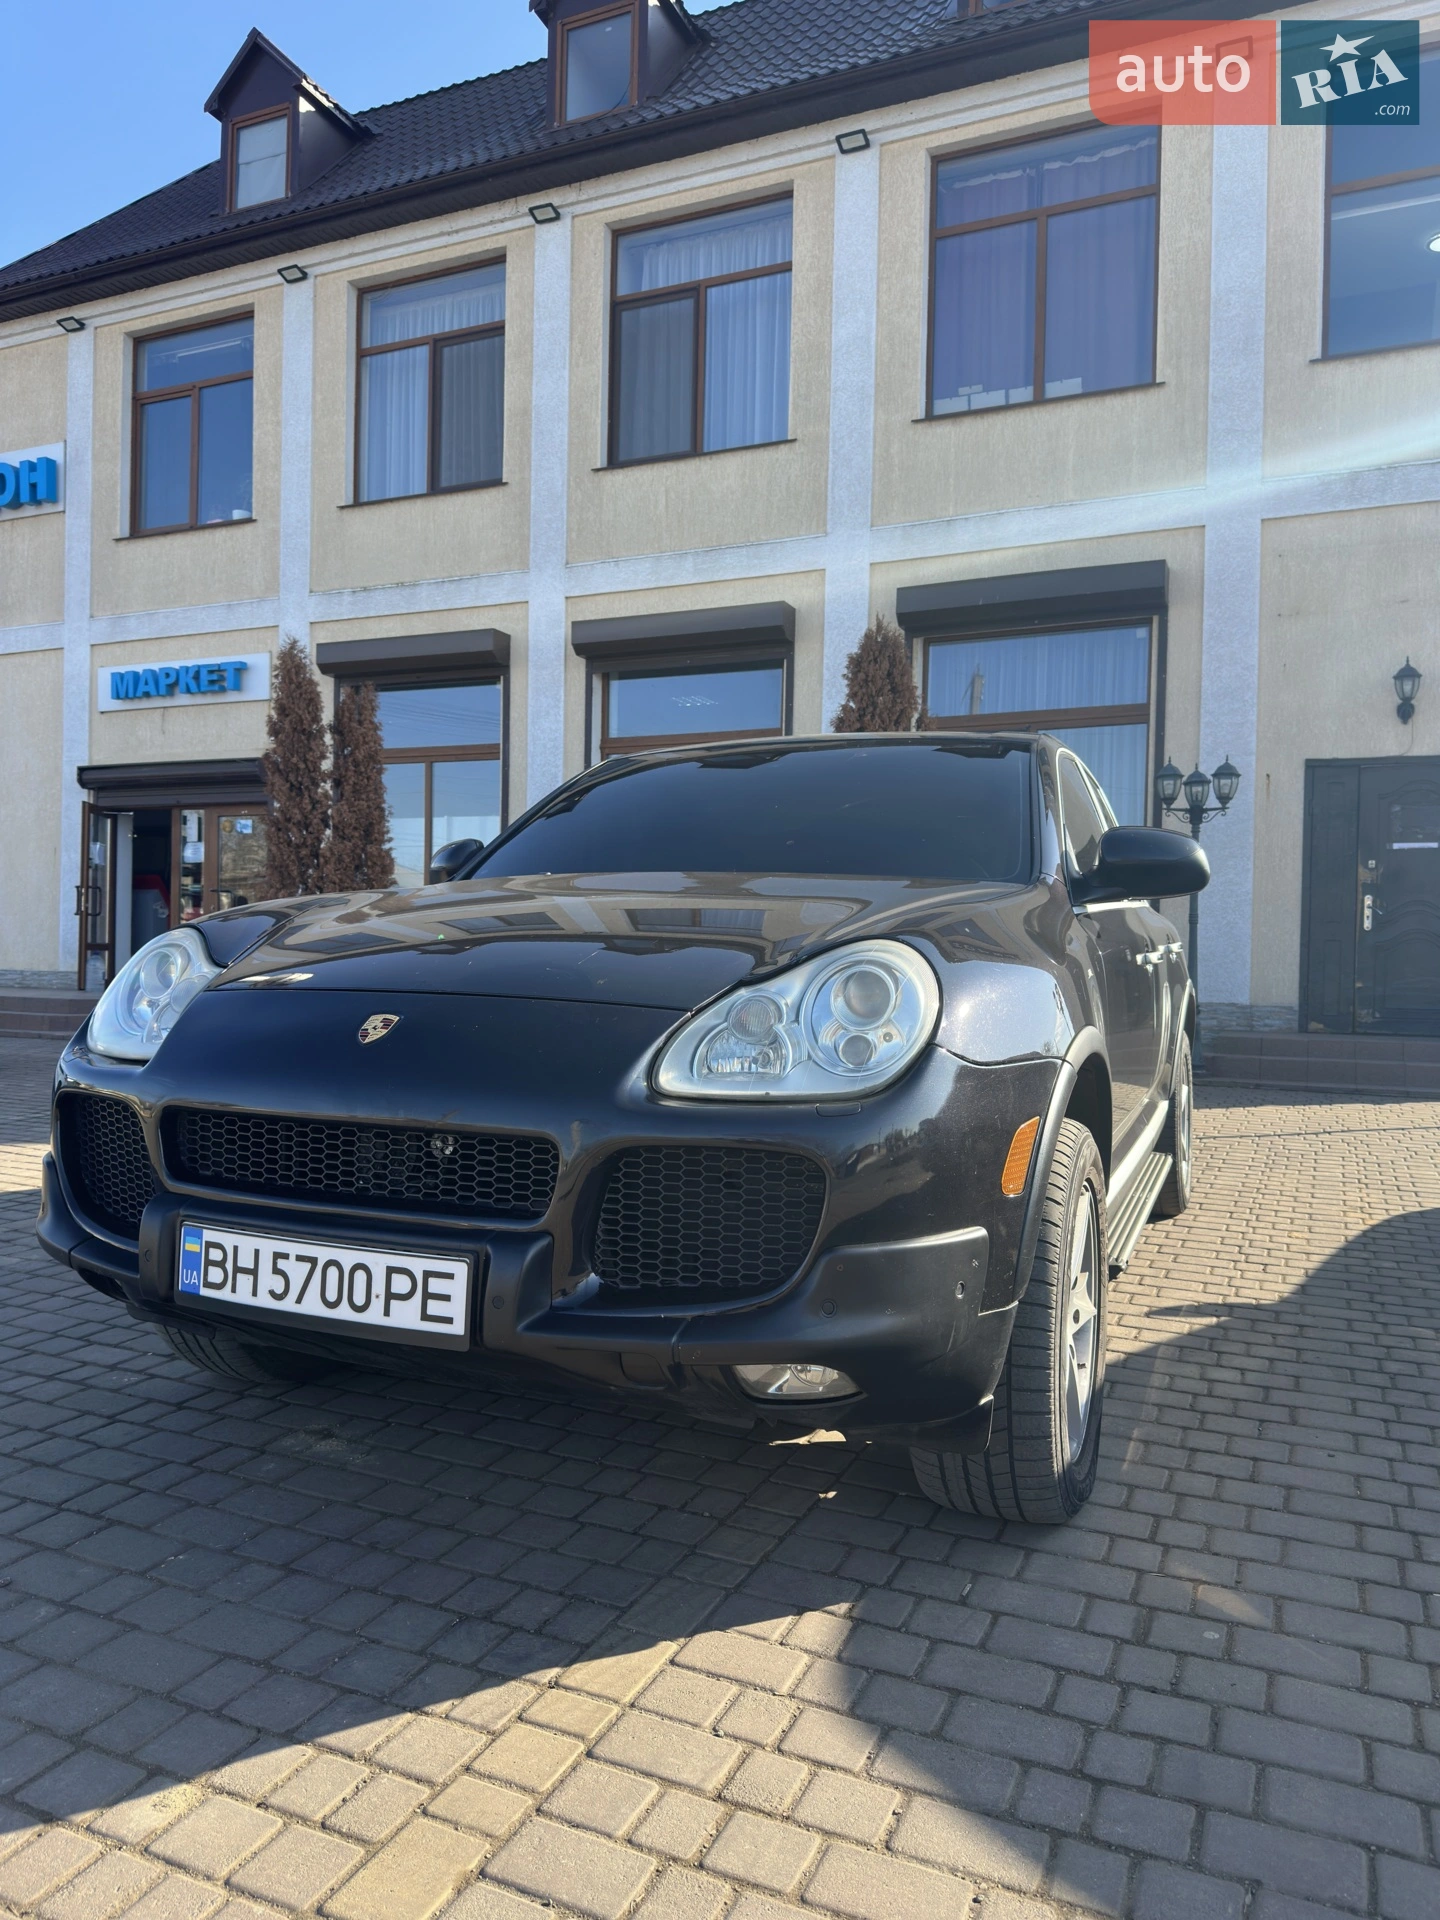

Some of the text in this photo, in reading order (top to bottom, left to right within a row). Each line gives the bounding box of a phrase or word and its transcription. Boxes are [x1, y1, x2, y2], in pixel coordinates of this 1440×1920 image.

[110, 660, 247, 700] МАРКЕТ
[183, 1268, 199, 1286] UA
[202, 1240, 455, 1325] BH 5700 PE
